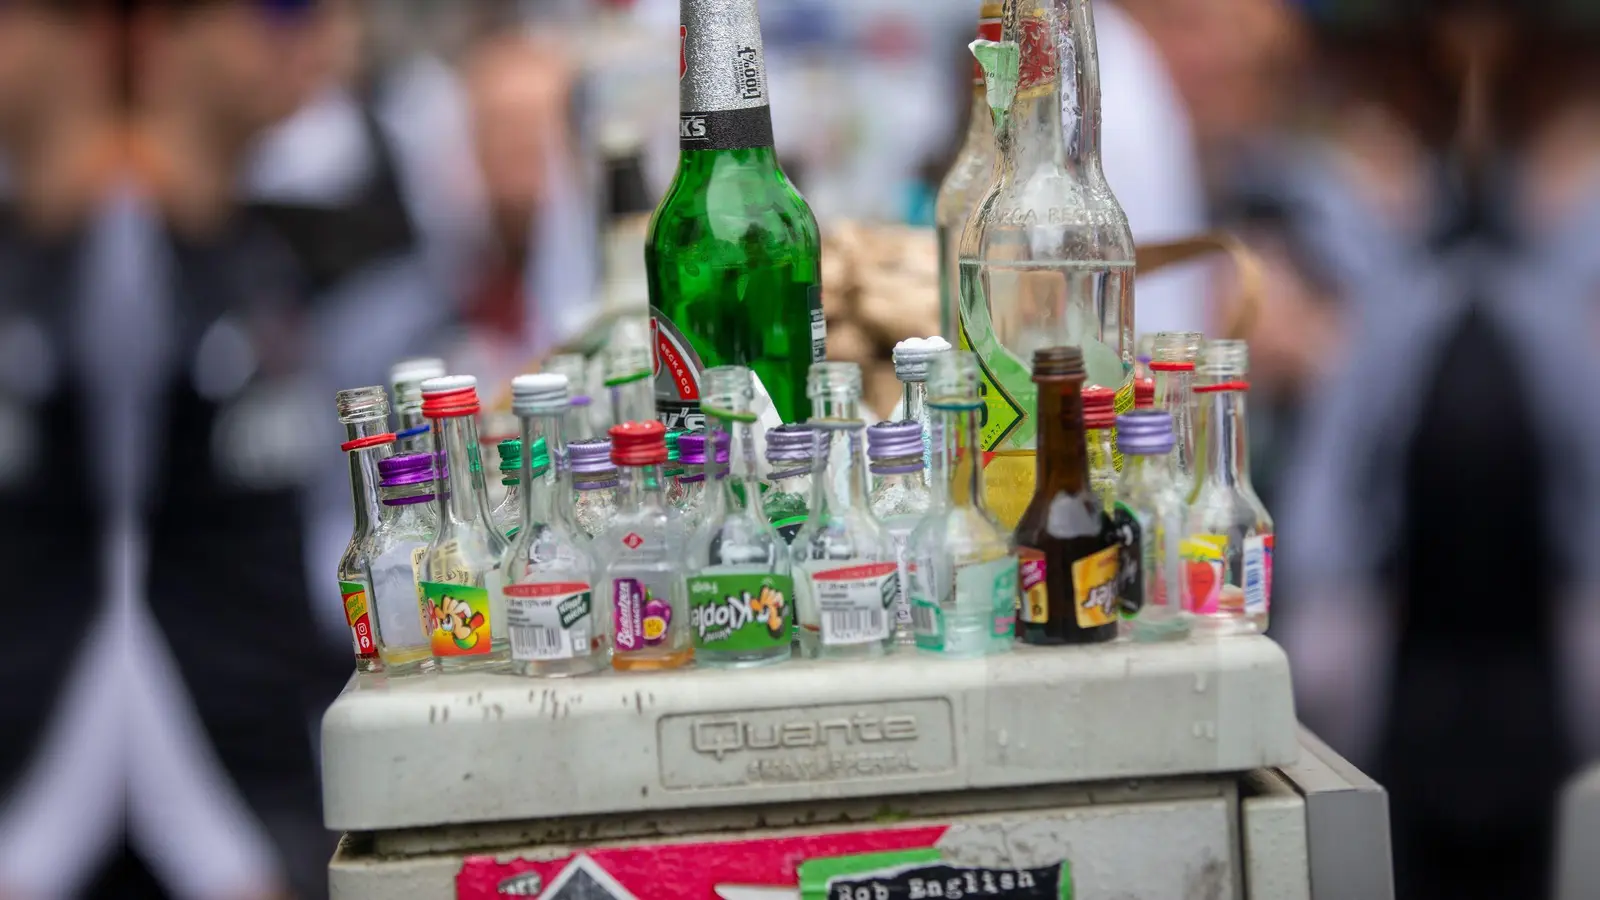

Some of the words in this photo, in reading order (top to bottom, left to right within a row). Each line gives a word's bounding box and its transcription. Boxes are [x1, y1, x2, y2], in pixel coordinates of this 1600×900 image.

[660, 342, 679, 369] BECK
[680, 377, 692, 395] CO
[691, 710, 919, 762] Quante
[907, 868, 1036, 900] English
